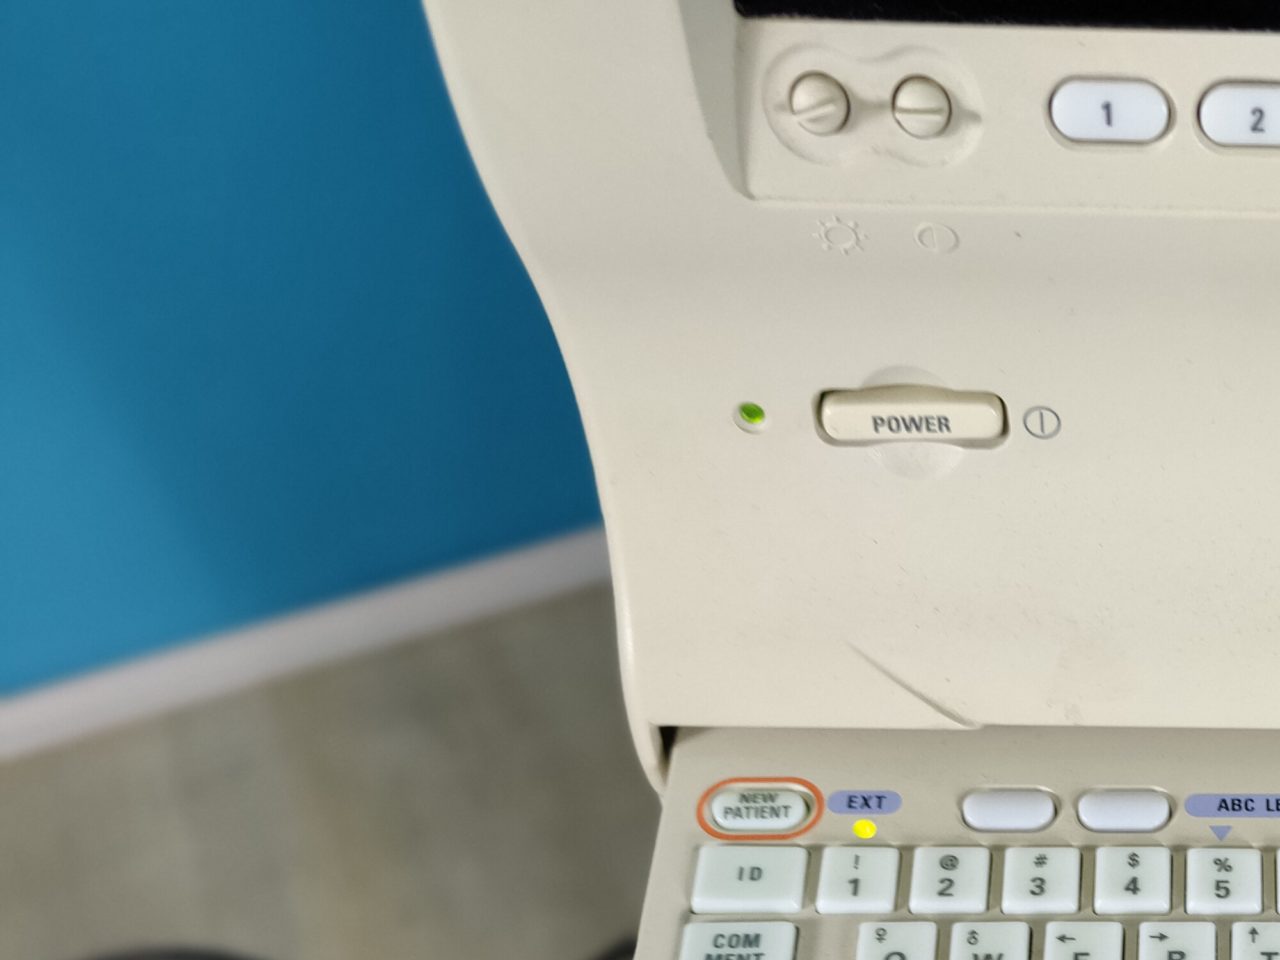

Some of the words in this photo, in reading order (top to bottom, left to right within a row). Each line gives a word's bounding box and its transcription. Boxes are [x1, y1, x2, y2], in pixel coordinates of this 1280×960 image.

[1101, 101, 1113, 127] 1
[1250, 107, 1265, 133] 2
[871, 415, 951, 434] POWER
[739, 789, 779, 804] NEW
[847, 795, 887, 809] EXT
[1217, 798, 1255, 812] ABC
[723, 804, 792, 820] PATIENT
[737, 866, 763, 882] ID
[847, 877, 861, 897] 1
[937, 877, 955, 897] 2
[1029, 876, 1046, 897] 3
[1123, 876, 1141, 895] 4
[1214, 879, 1231, 899] 5
[712, 933, 761, 949] COM
